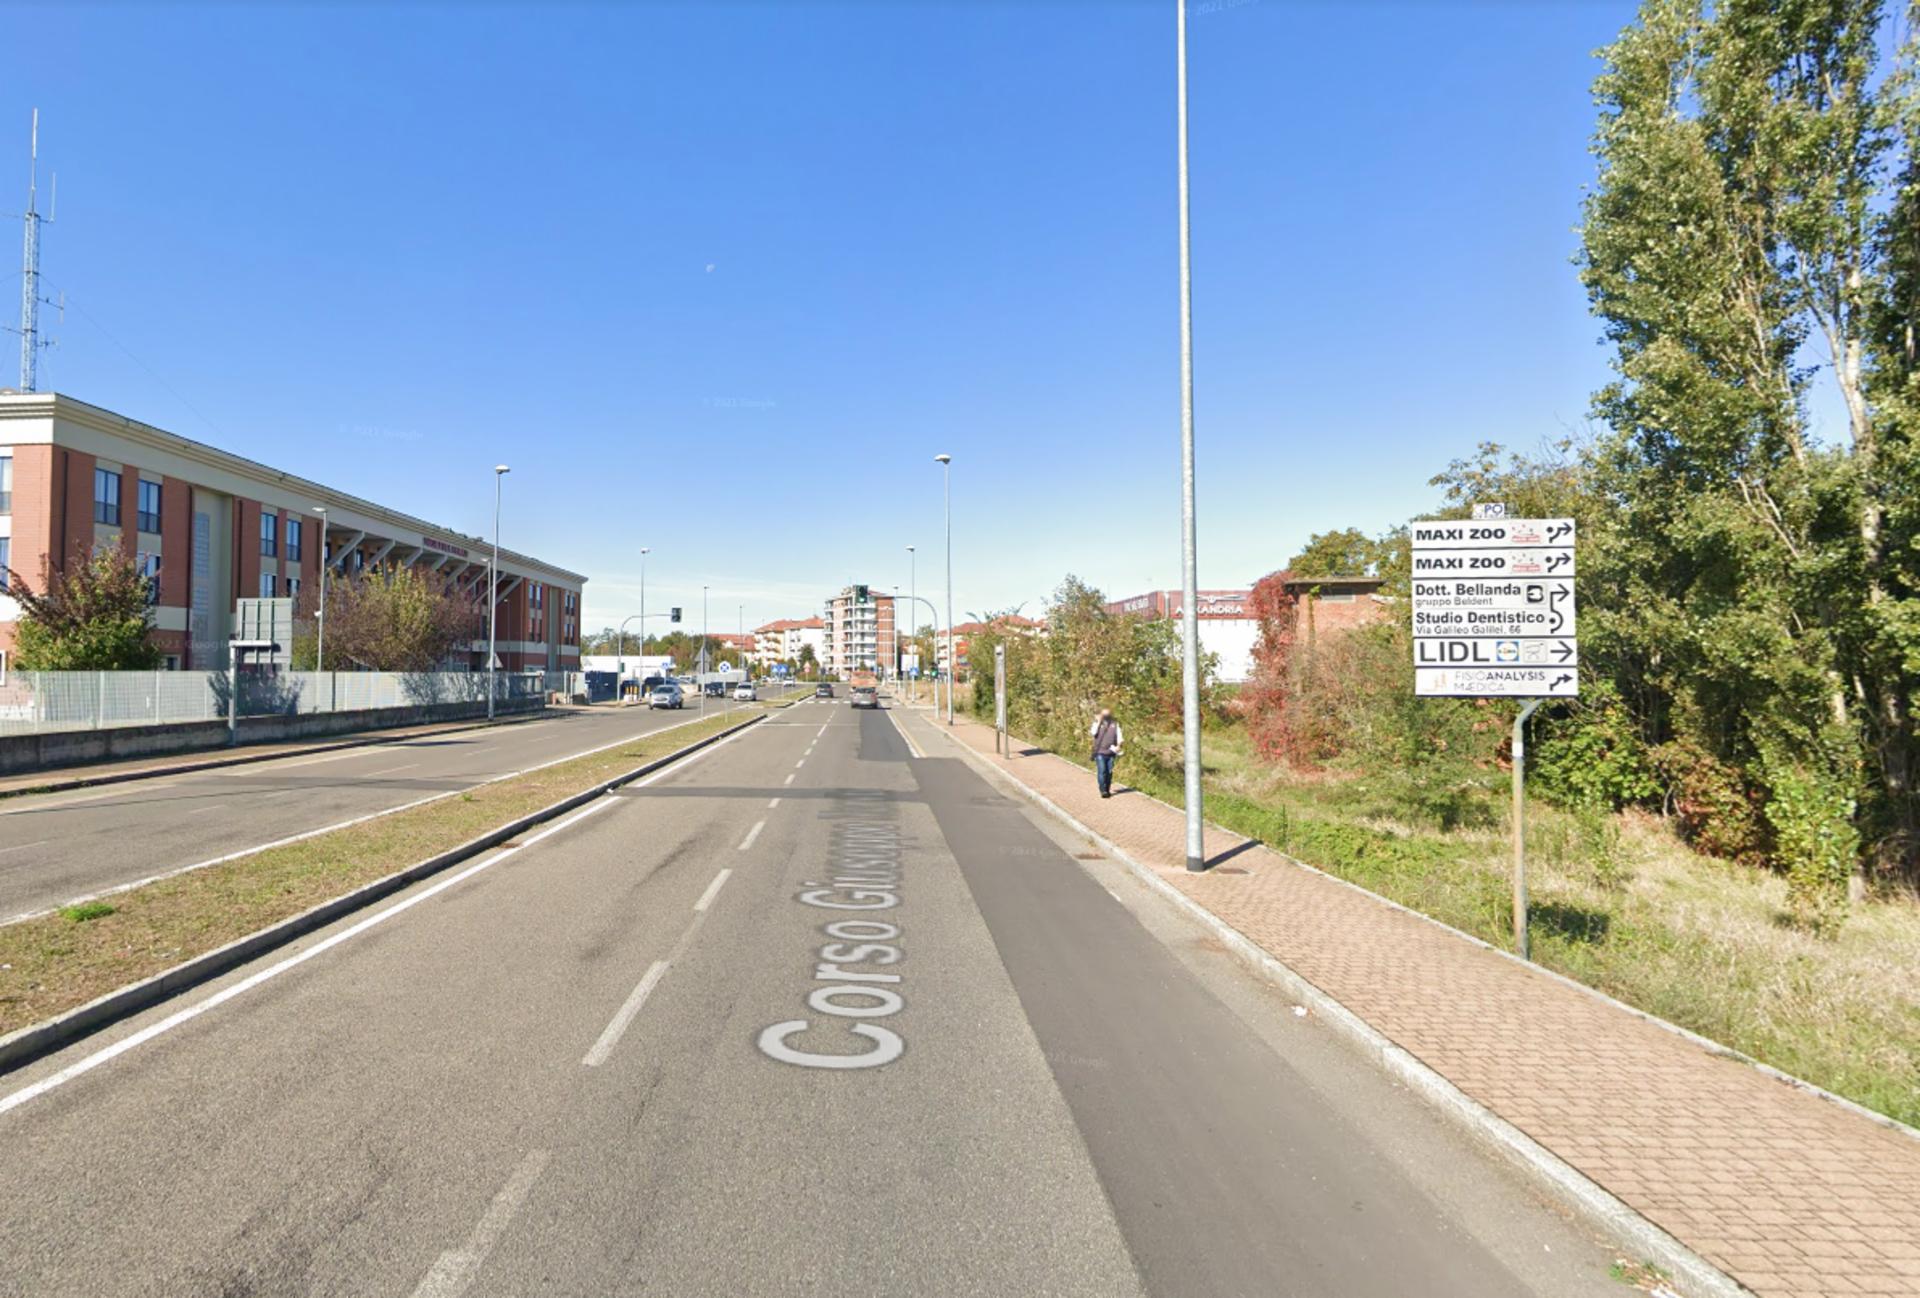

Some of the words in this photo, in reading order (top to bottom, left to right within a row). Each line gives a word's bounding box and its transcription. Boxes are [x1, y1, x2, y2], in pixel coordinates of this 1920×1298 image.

[1416, 529, 1463, 540] MAXI
[1469, 528, 1506, 540] ZOO
[1416, 558, 1463, 569] MAXI
[1469, 557, 1506, 569] ZOO
[1415, 584, 1451, 596] Dott.
[1456, 583, 1521, 596] Bellanda
[1415, 598, 1451, 608] gruppo
[1454, 597, 1493, 605] Beldent
[1175, 604, 1244, 616] AANDRIA
[1416, 612, 1463, 624] Studio
[1468, 611, 1545, 624] Dentistico
[1416, 626, 1431, 634] Via
[1434, 625, 1469, 634] Galileo
[1420, 642, 1490, 662] LIDL
